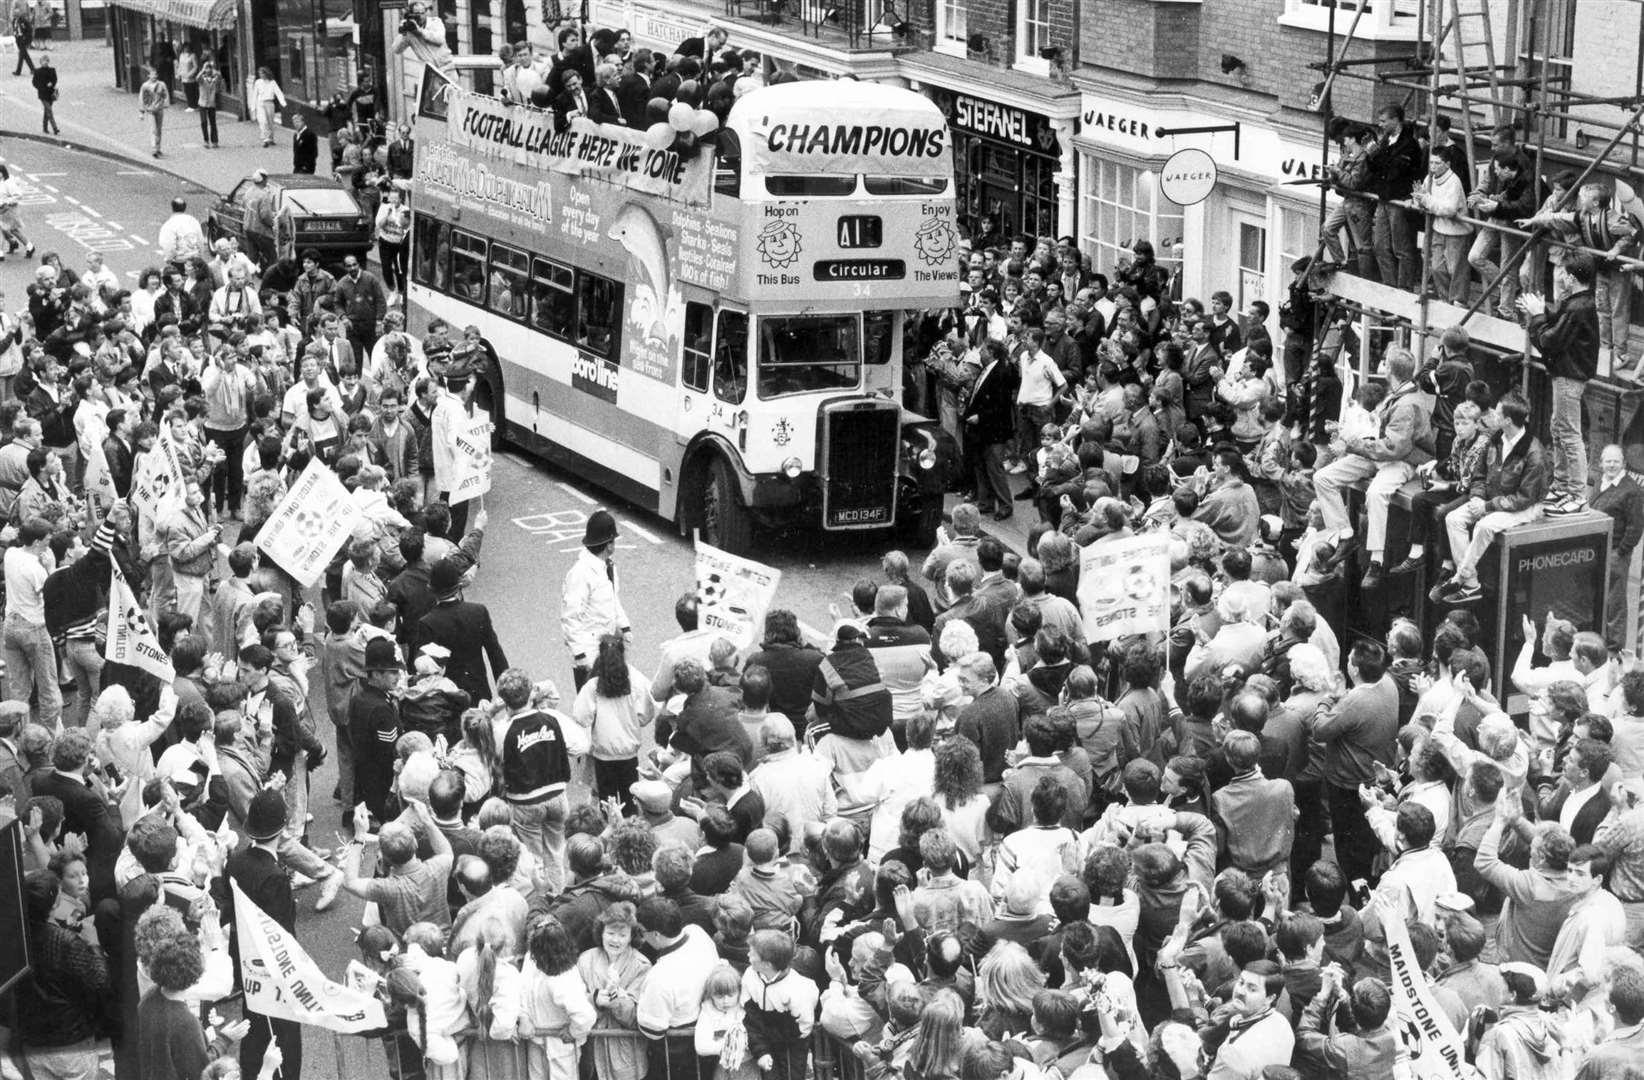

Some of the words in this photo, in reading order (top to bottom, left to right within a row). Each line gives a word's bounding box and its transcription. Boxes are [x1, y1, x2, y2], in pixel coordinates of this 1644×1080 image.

[956, 95, 1032, 145] STEFANEL
[1084, 110, 1150, 140] JAEGER
[462, 106, 524, 149] FOOTBALL
[578, 133, 619, 166] HERE
[617, 142, 643, 172] WE
[643, 148, 687, 185] COME
[1165, 172, 1212, 182] JAEGER
[570, 185, 590, 206] Open
[585, 208, 600, 231] day
[765, 206, 785, 219] Hop
[786, 208, 799, 216] on
[922, 204, 951, 218] Enjoy
[757, 274, 779, 285] This
[781, 274, 800, 285] Bus
[828, 263, 889, 278] Circular
[914, 270, 931, 281] The
[932, 269, 959, 281] Views
[852, 284, 872, 297] 34
[1518, 548, 1596, 573] PHONECARD
[135, 641, 169, 666] STONES
[244, 977, 262, 996] UP
[1389, 943, 1443, 1042] MAIDSTONE
